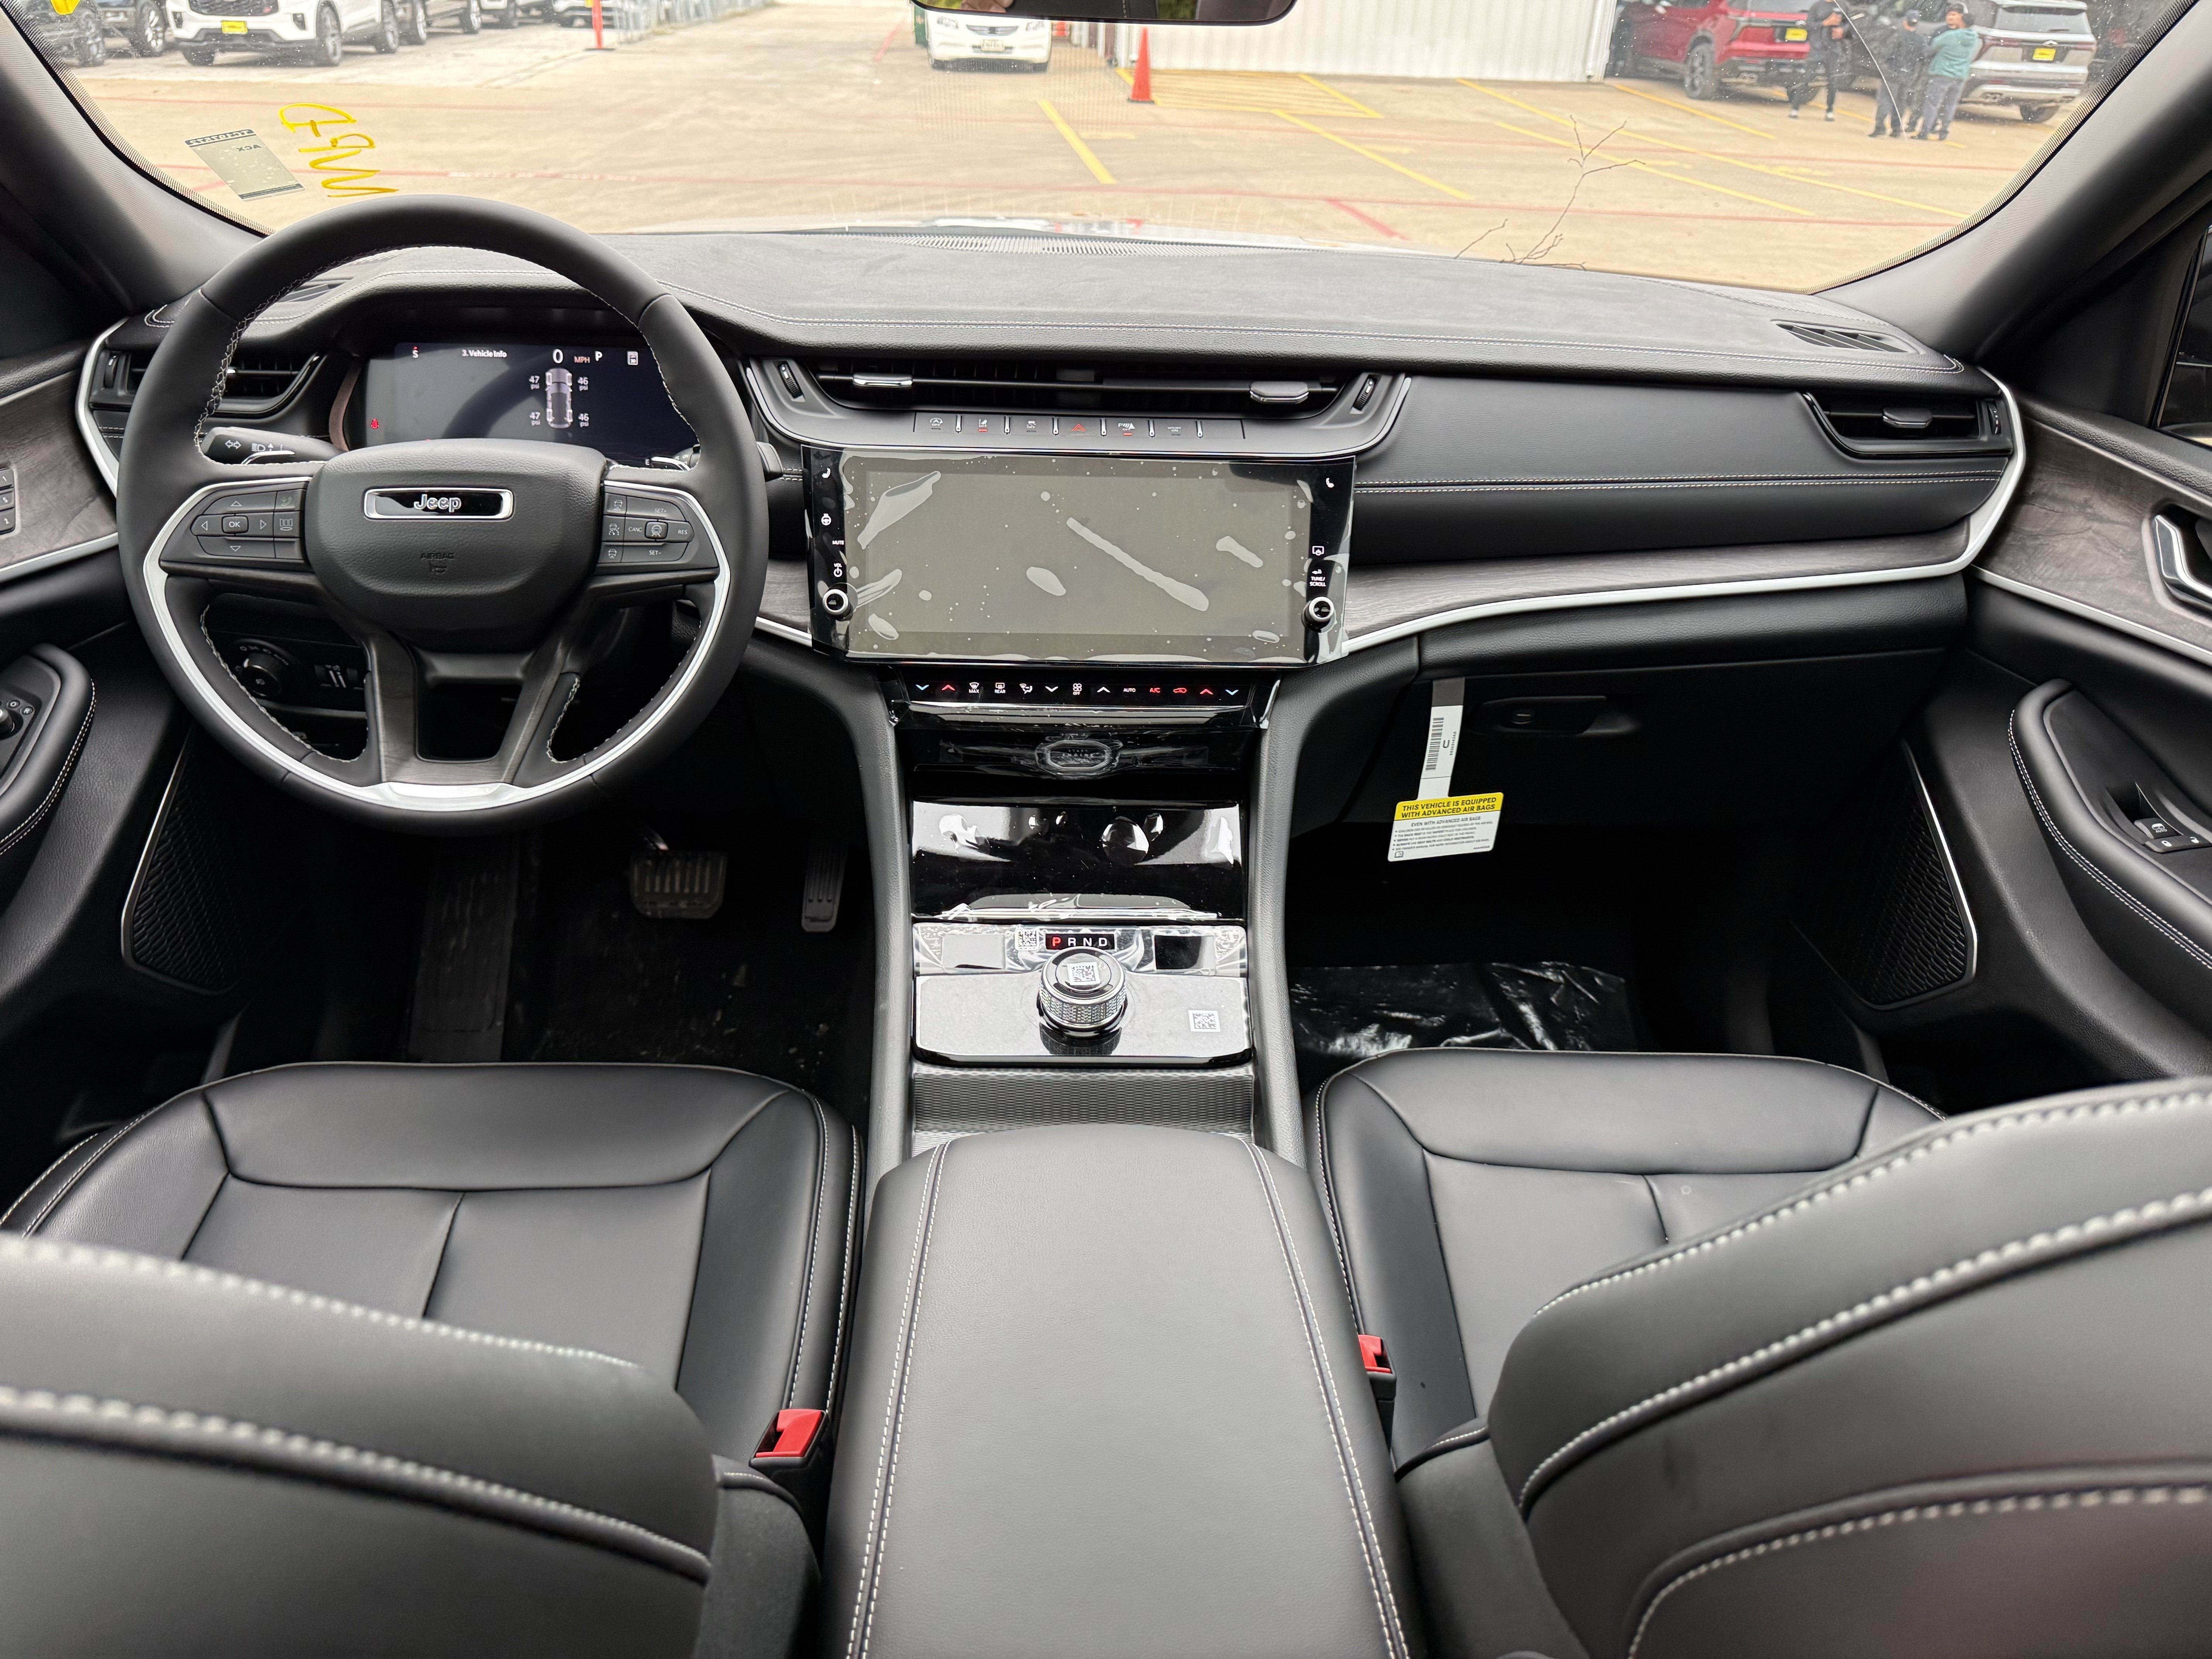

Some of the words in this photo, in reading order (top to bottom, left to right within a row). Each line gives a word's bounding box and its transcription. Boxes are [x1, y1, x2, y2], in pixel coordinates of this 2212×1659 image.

[412, 350, 418, 358] S
[595, 351, 603, 361] P
[577, 376, 589, 385] 46
[578, 413, 589, 421] 46
[414, 494, 462, 513] Jeep
[1443, 740, 1450, 748] U
[1421, 801, 1451, 809] VEHICLE
[1461, 797, 1497, 805] EQUIPPED
[1422, 807, 1461, 816] ADVANCED
[1052, 936, 1061, 947] P
[1068, 937, 1076, 946] R
[1083, 937, 1092, 946] N
[1098, 937, 1108, 946] D
